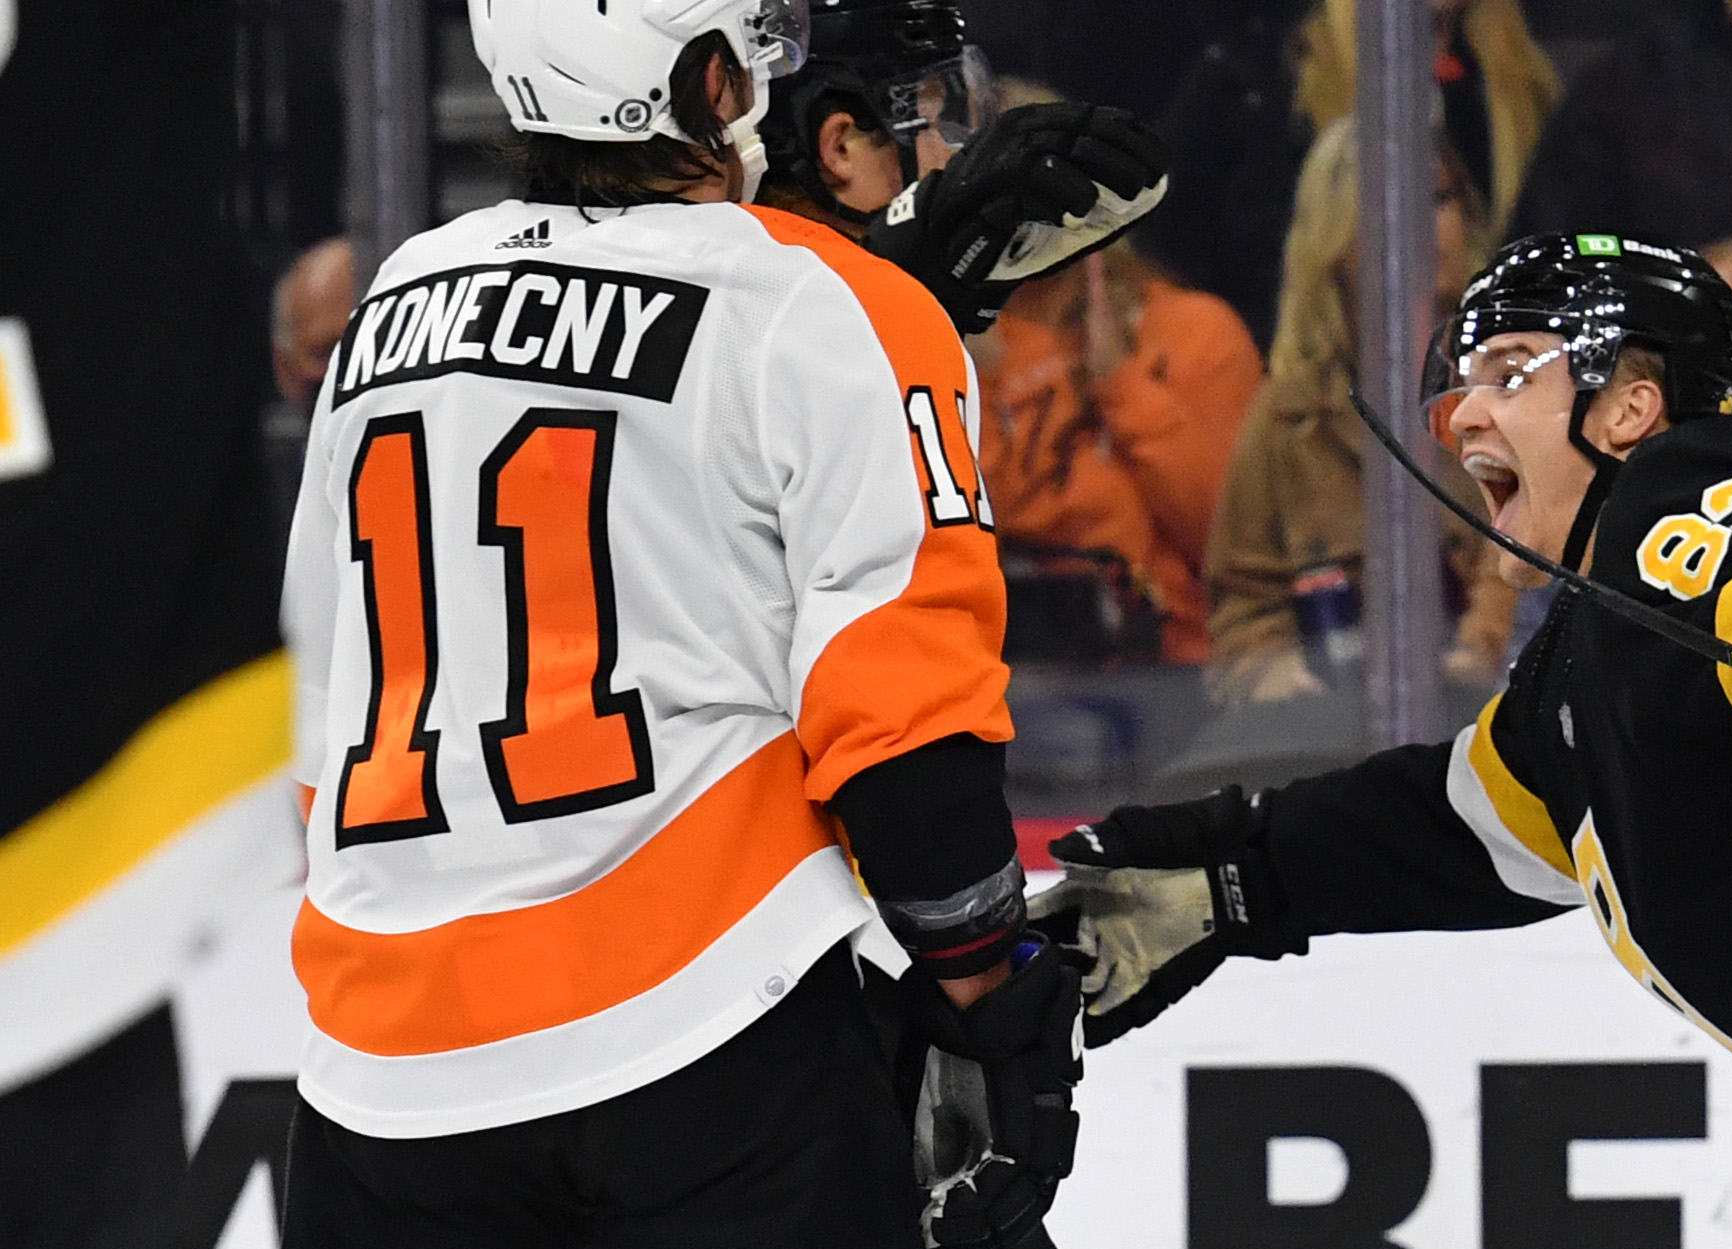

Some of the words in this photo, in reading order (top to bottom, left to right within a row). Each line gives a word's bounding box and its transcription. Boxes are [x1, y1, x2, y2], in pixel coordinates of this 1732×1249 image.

[507, 75, 549, 122] 11
[1622, 239, 1682, 264] Bank
[340, 271, 676, 392] KONECNY
[336, 407, 655, 850] 11
